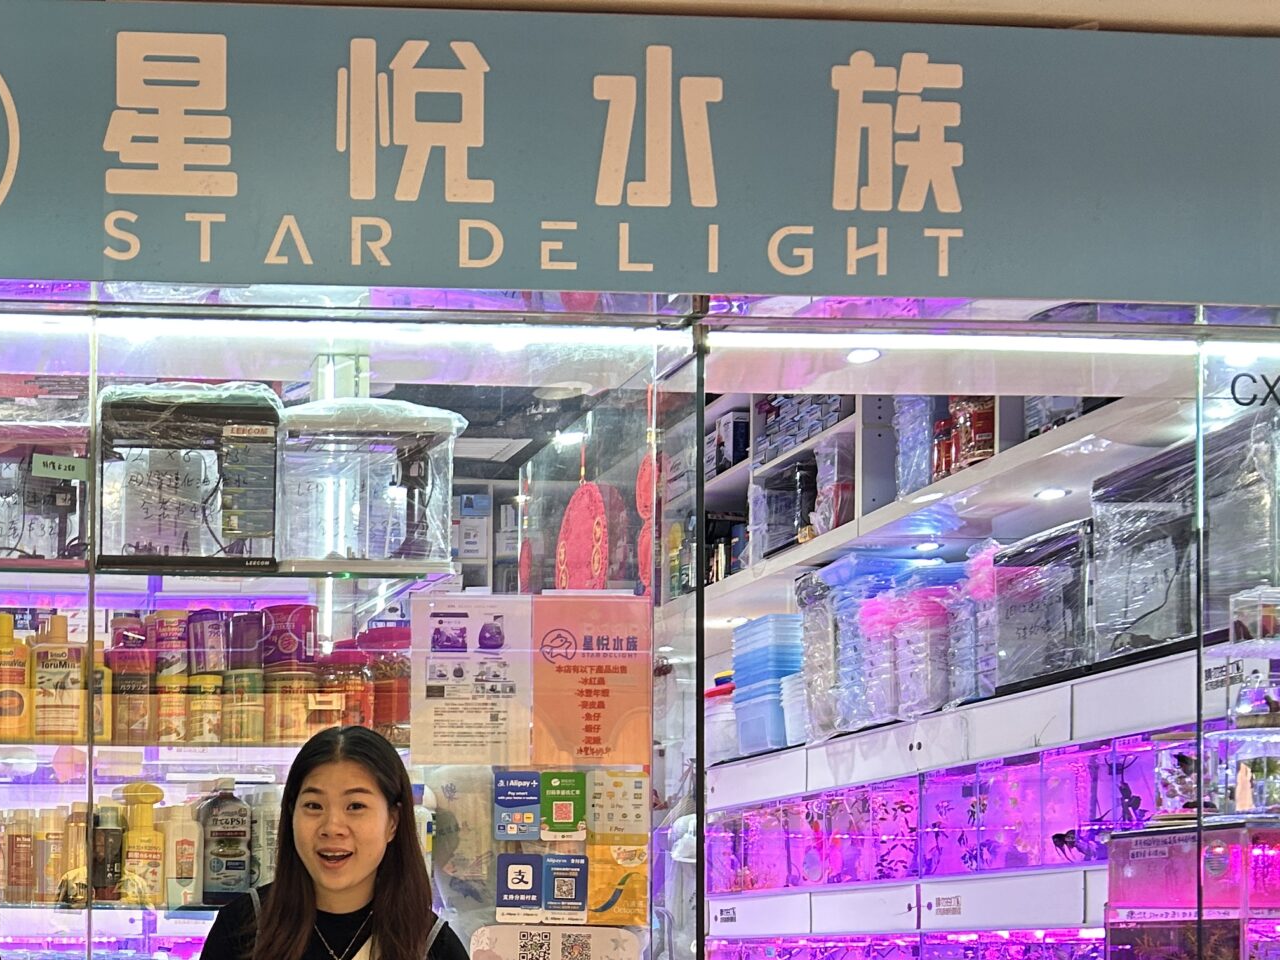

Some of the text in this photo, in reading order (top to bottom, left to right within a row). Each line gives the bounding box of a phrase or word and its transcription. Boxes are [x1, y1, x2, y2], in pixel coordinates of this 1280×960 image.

[103, 210, 964, 277] STAR DELIGHT
[41, 661, 76, 670] ToruMin
